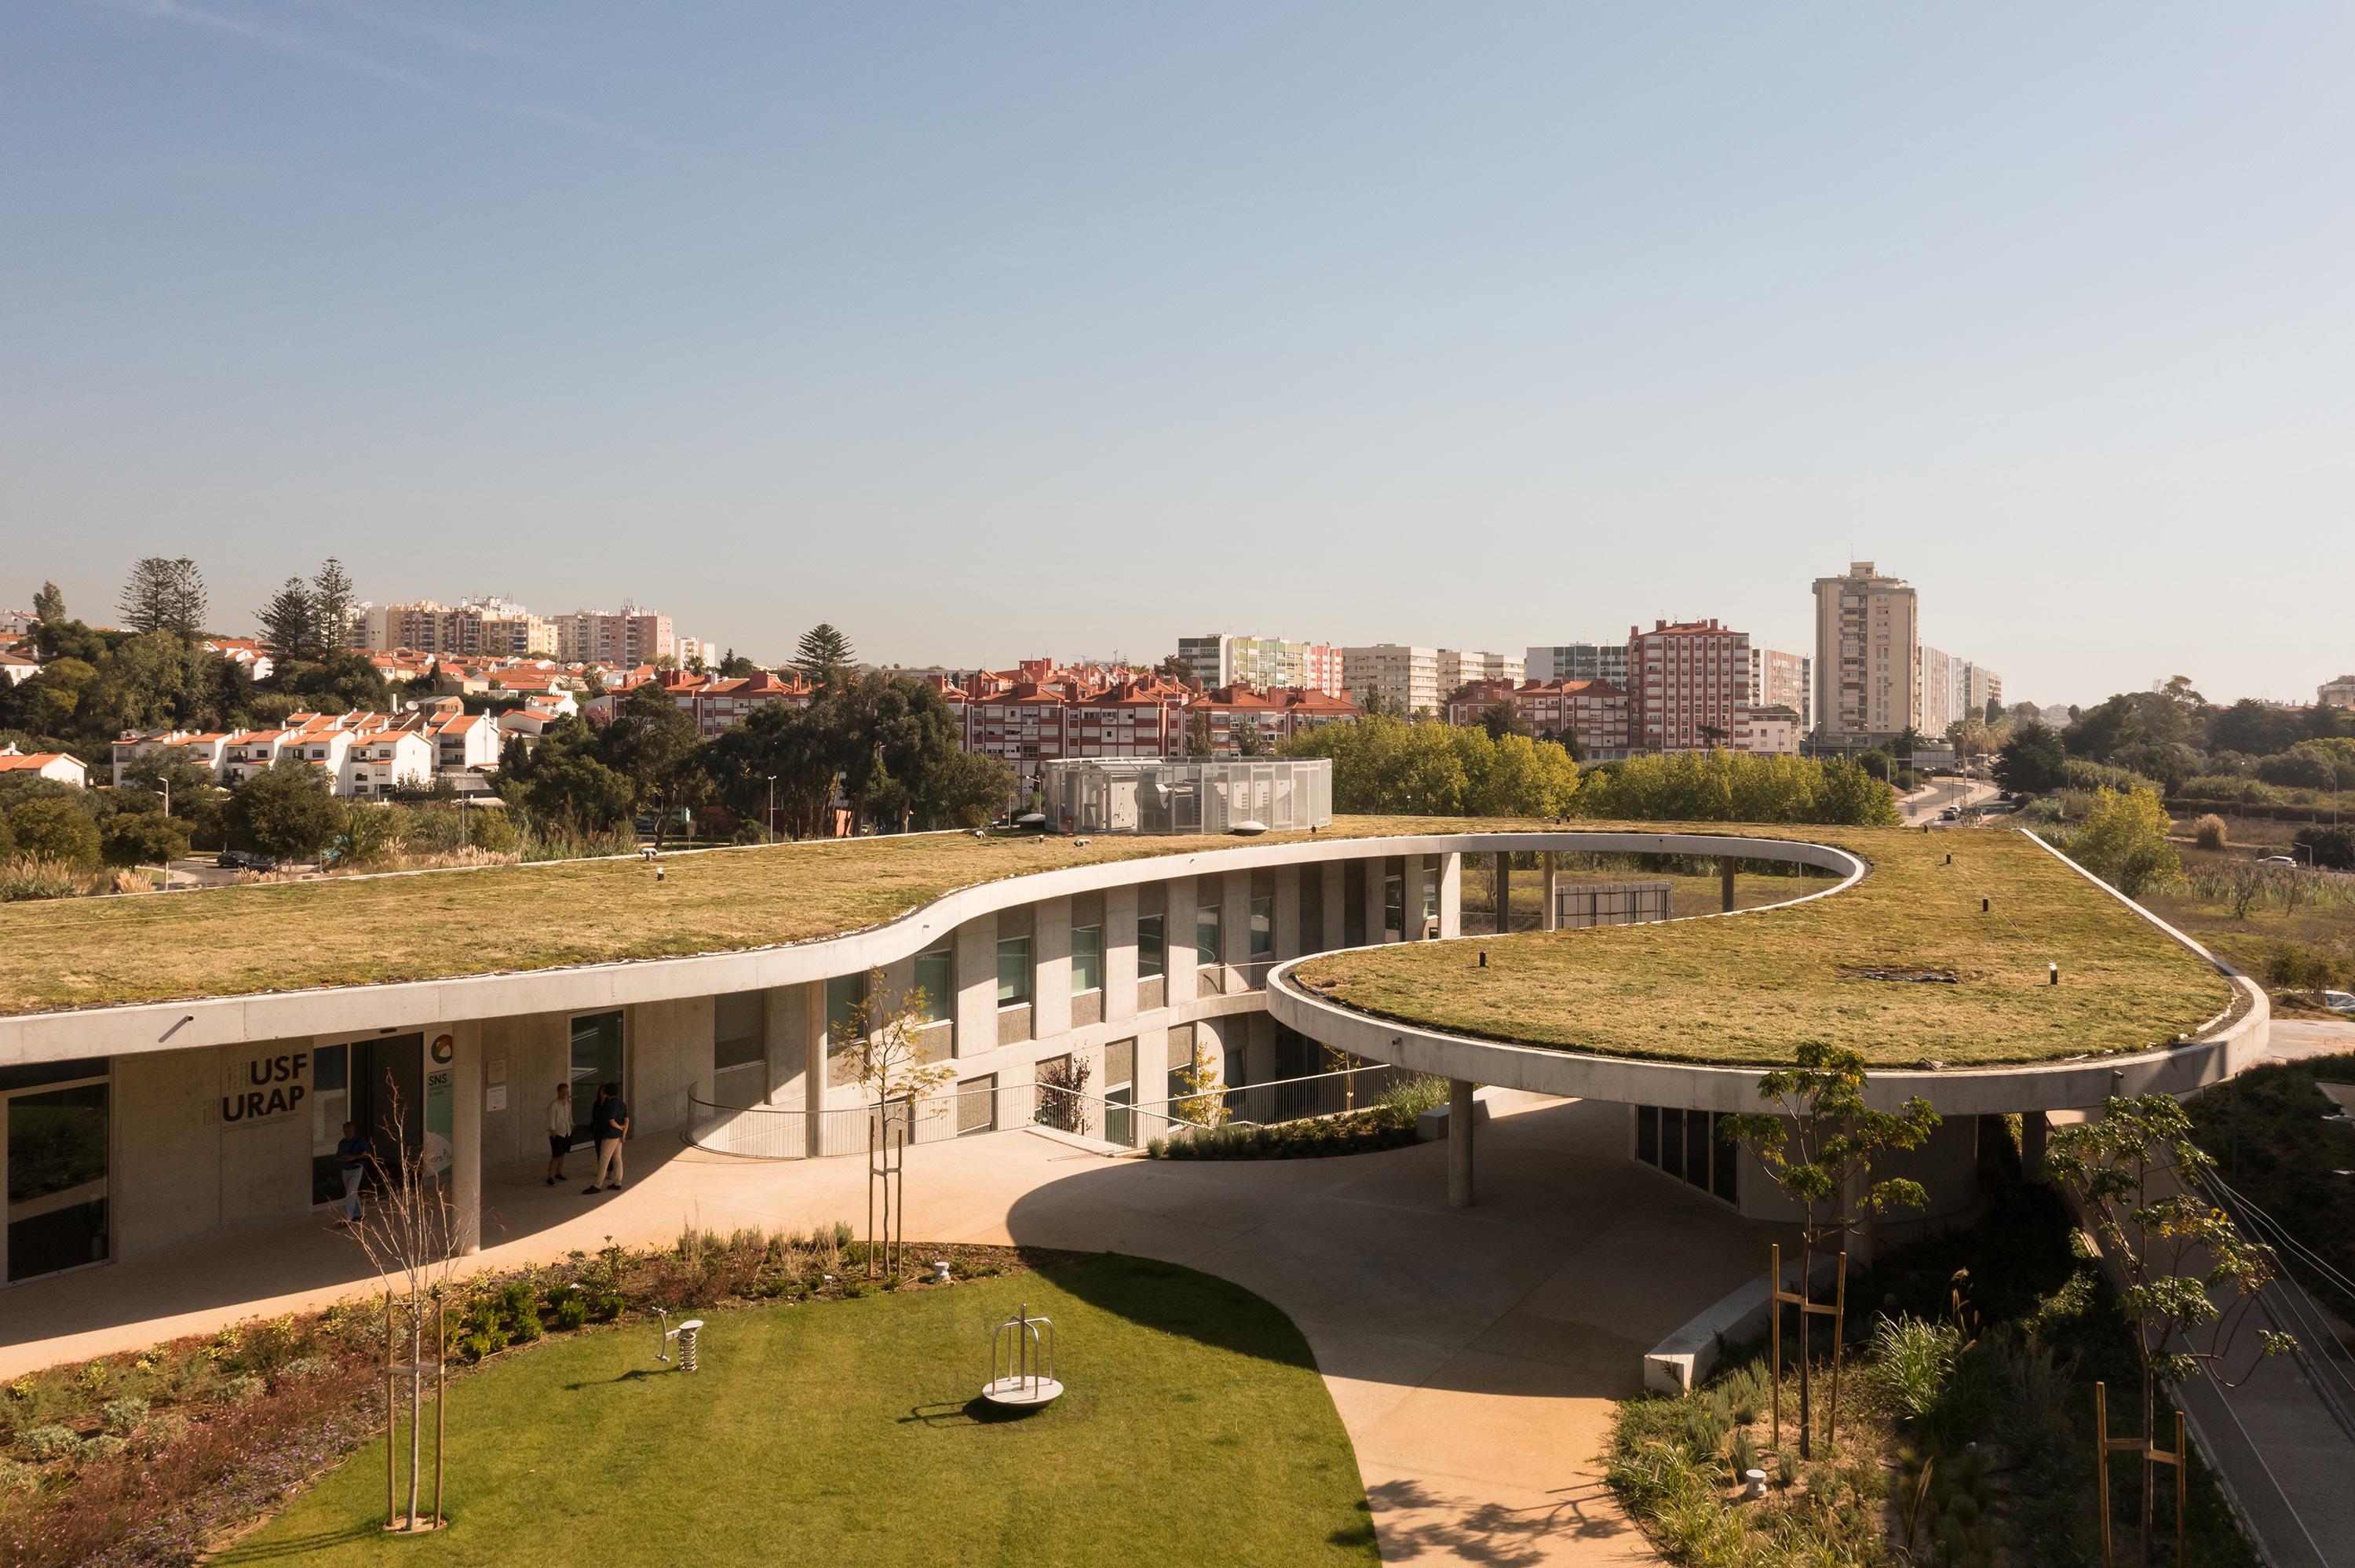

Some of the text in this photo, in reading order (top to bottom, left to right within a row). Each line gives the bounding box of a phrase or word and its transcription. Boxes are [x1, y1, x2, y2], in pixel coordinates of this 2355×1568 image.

[250, 1053, 307, 1085] USF
[429, 1073, 447, 1086] SNS
[222, 1085, 305, 1121] URAP
